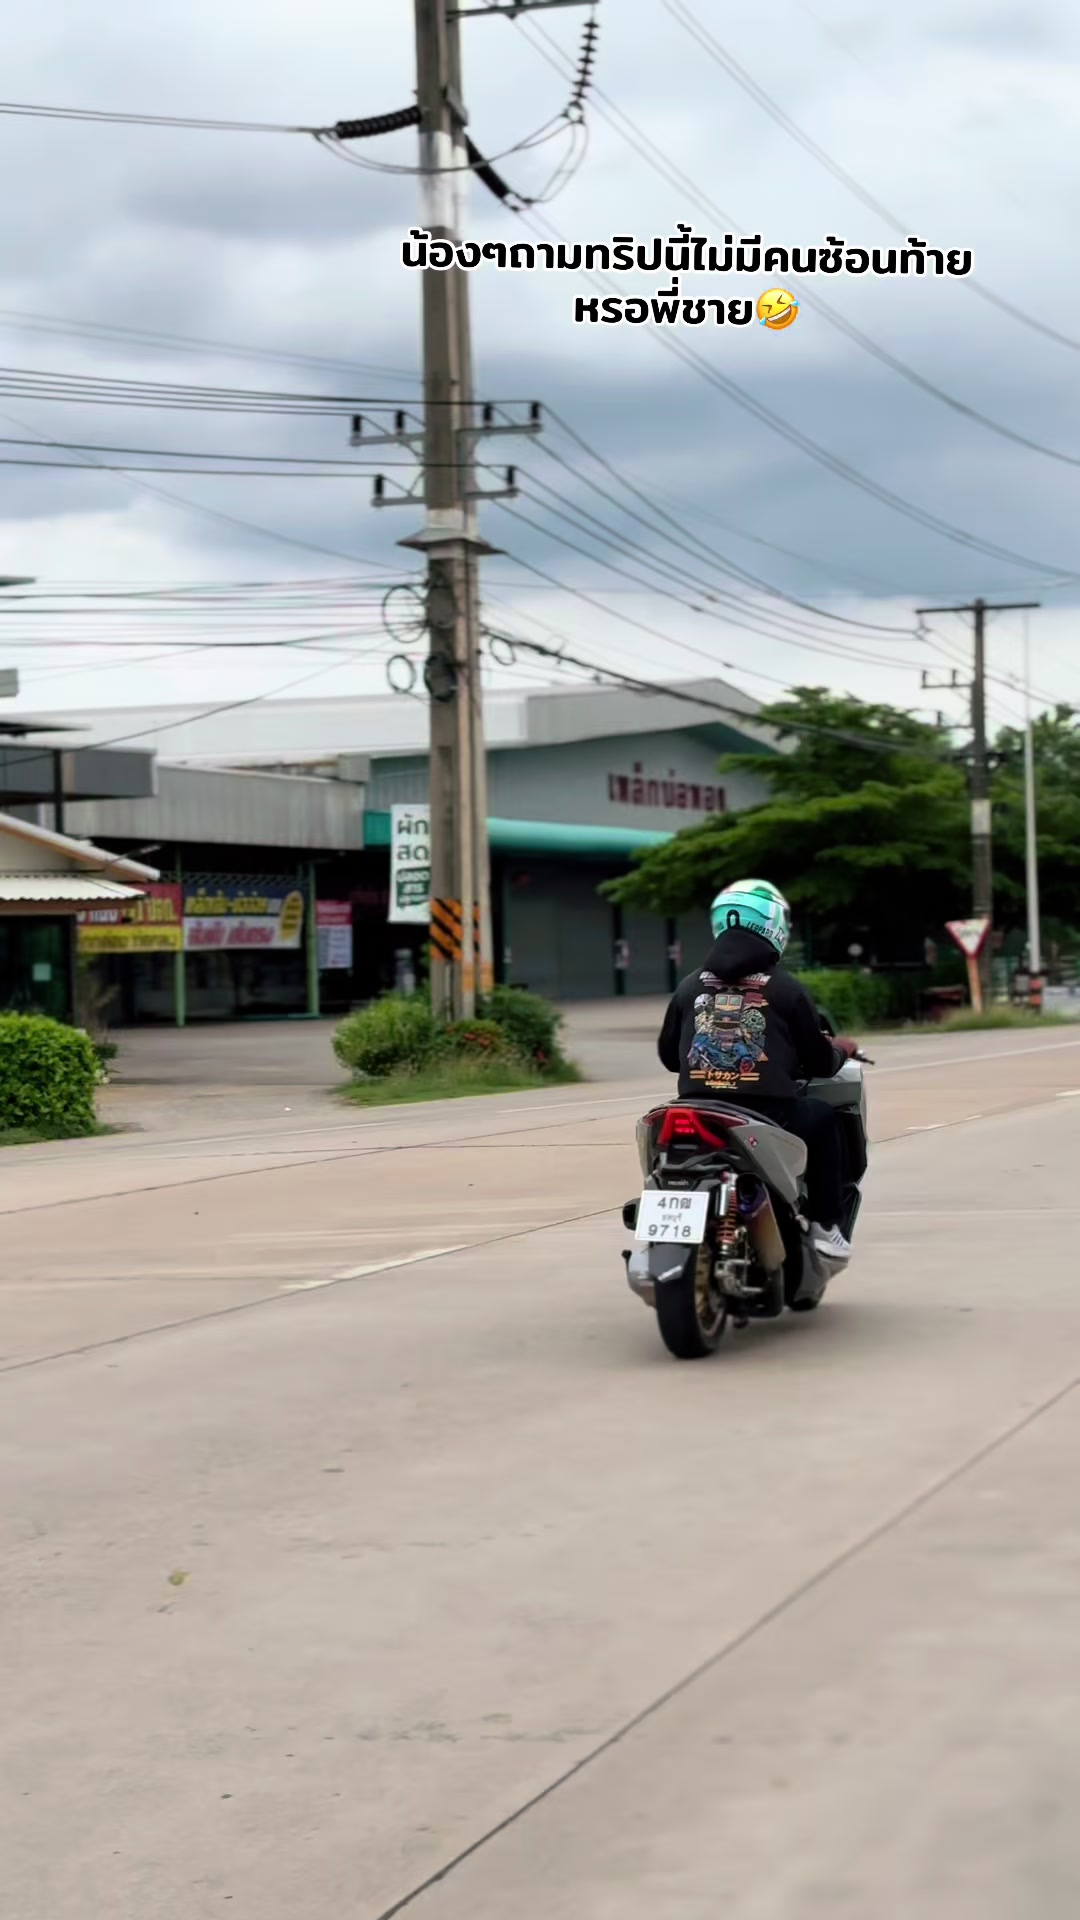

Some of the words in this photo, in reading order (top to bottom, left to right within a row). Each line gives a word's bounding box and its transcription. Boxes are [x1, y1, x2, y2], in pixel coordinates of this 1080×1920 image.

[397, 813, 430, 835] ผัก
[397, 844, 430, 861] สด
[648, 1223, 692, 1238] 9718
